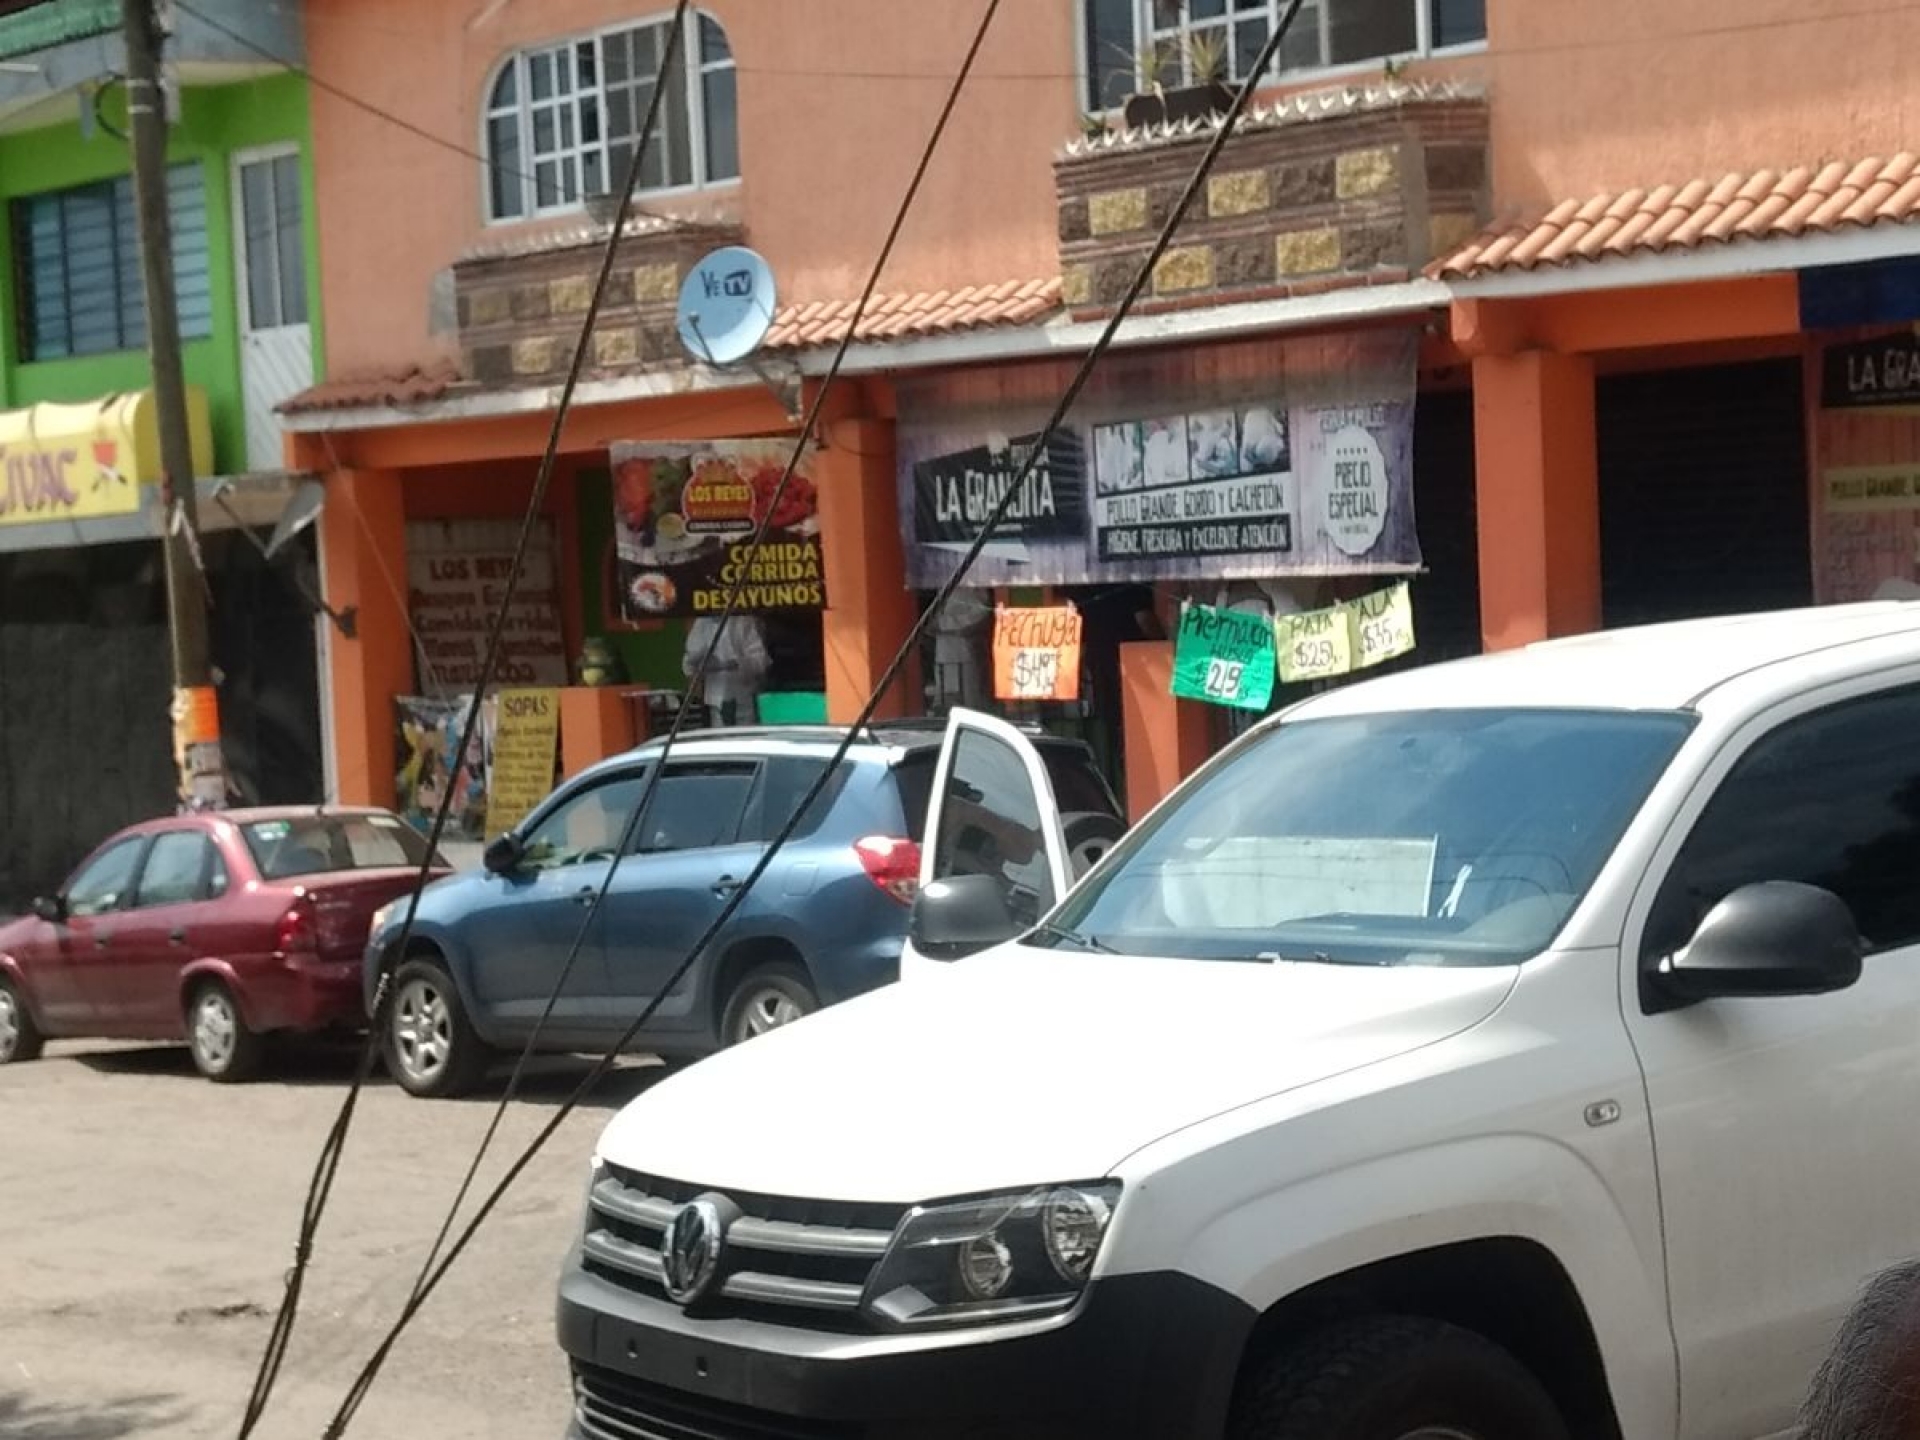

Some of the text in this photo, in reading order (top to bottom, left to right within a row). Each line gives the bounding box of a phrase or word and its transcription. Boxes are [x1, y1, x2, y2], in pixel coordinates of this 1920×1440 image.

[1848, 355, 1877, 391] LA
[1334, 461, 1371, 489] PRECIO
[936, 475, 962, 522] LA
[1106, 499, 1138, 524] POLLO
[1184, 488, 1216, 517] GORDO
[1218, 492, 1225, 515] Y
[1328, 491, 1379, 519] ESPECIAL
[730, 544, 818, 564] COMIDA
[720, 561, 818, 584] CORRIDA
[692, 585, 822, 610] DESAYUNOS
[503, 694, 549, 718] SOPAS
